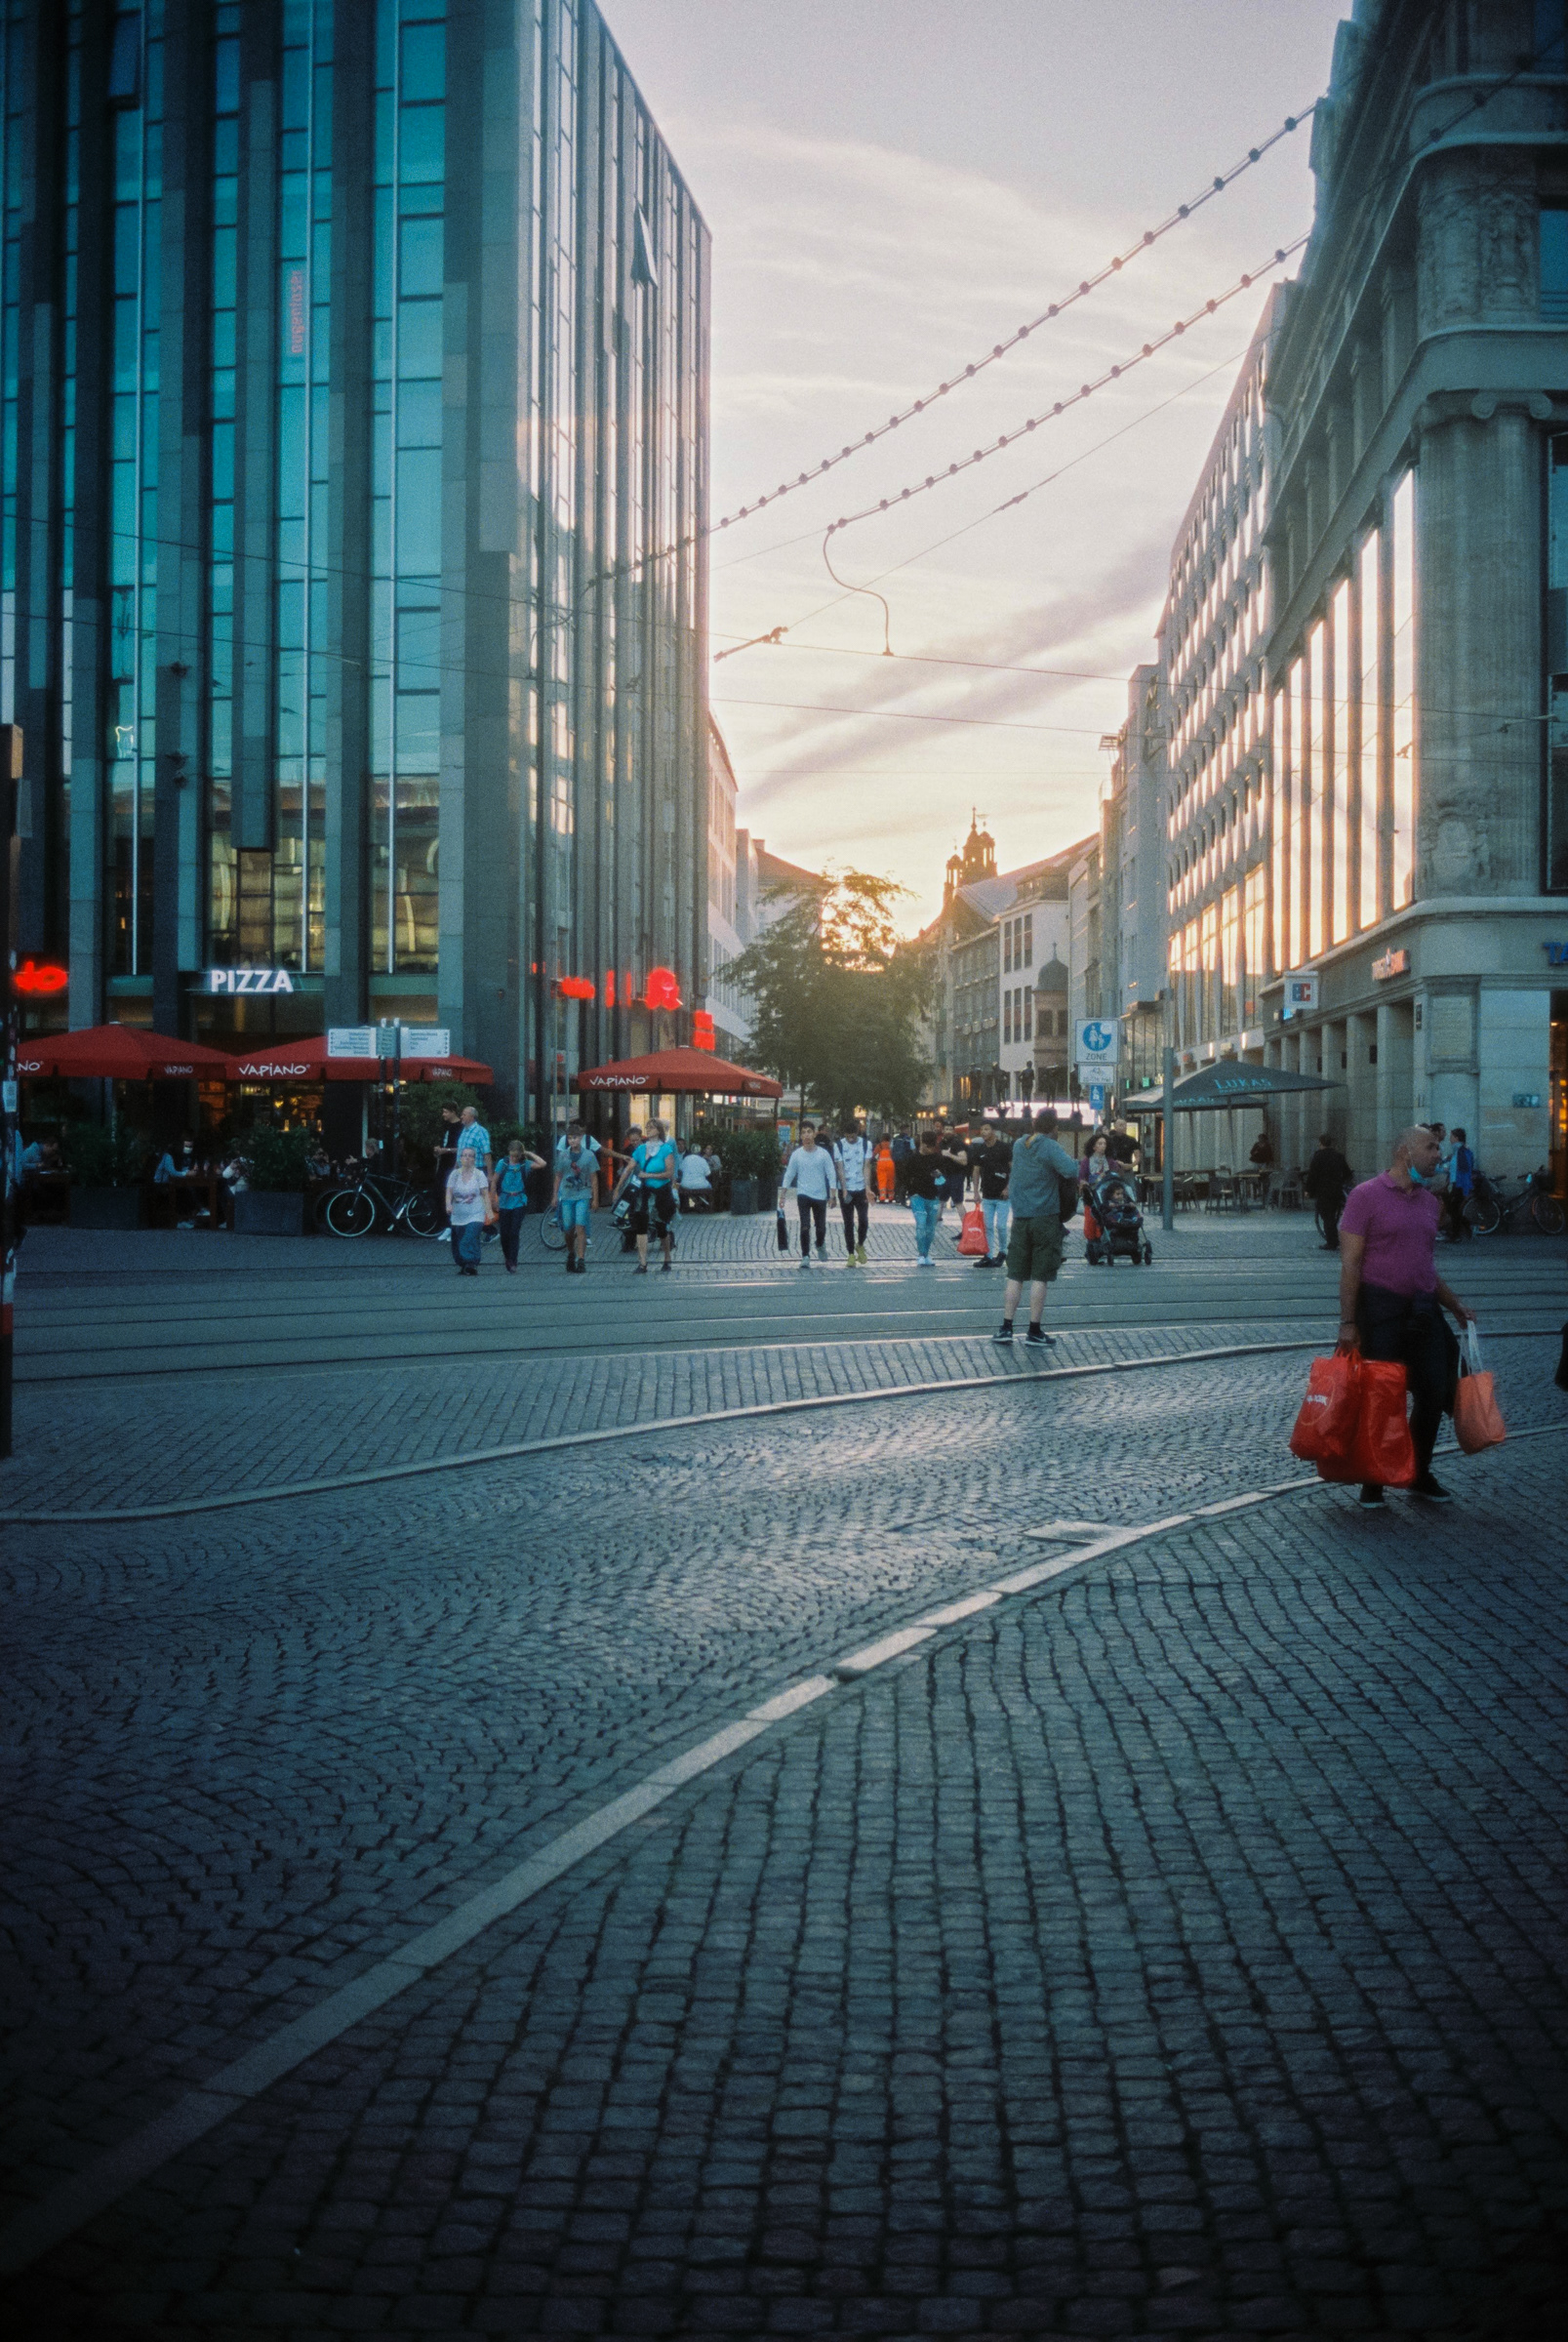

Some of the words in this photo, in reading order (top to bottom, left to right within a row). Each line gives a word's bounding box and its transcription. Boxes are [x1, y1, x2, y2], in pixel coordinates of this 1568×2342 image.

[211, 970, 294, 992] PIZZA
[1292, 983, 1311, 1002] EC
[1214, 1077, 1272, 1089] LUKAS
